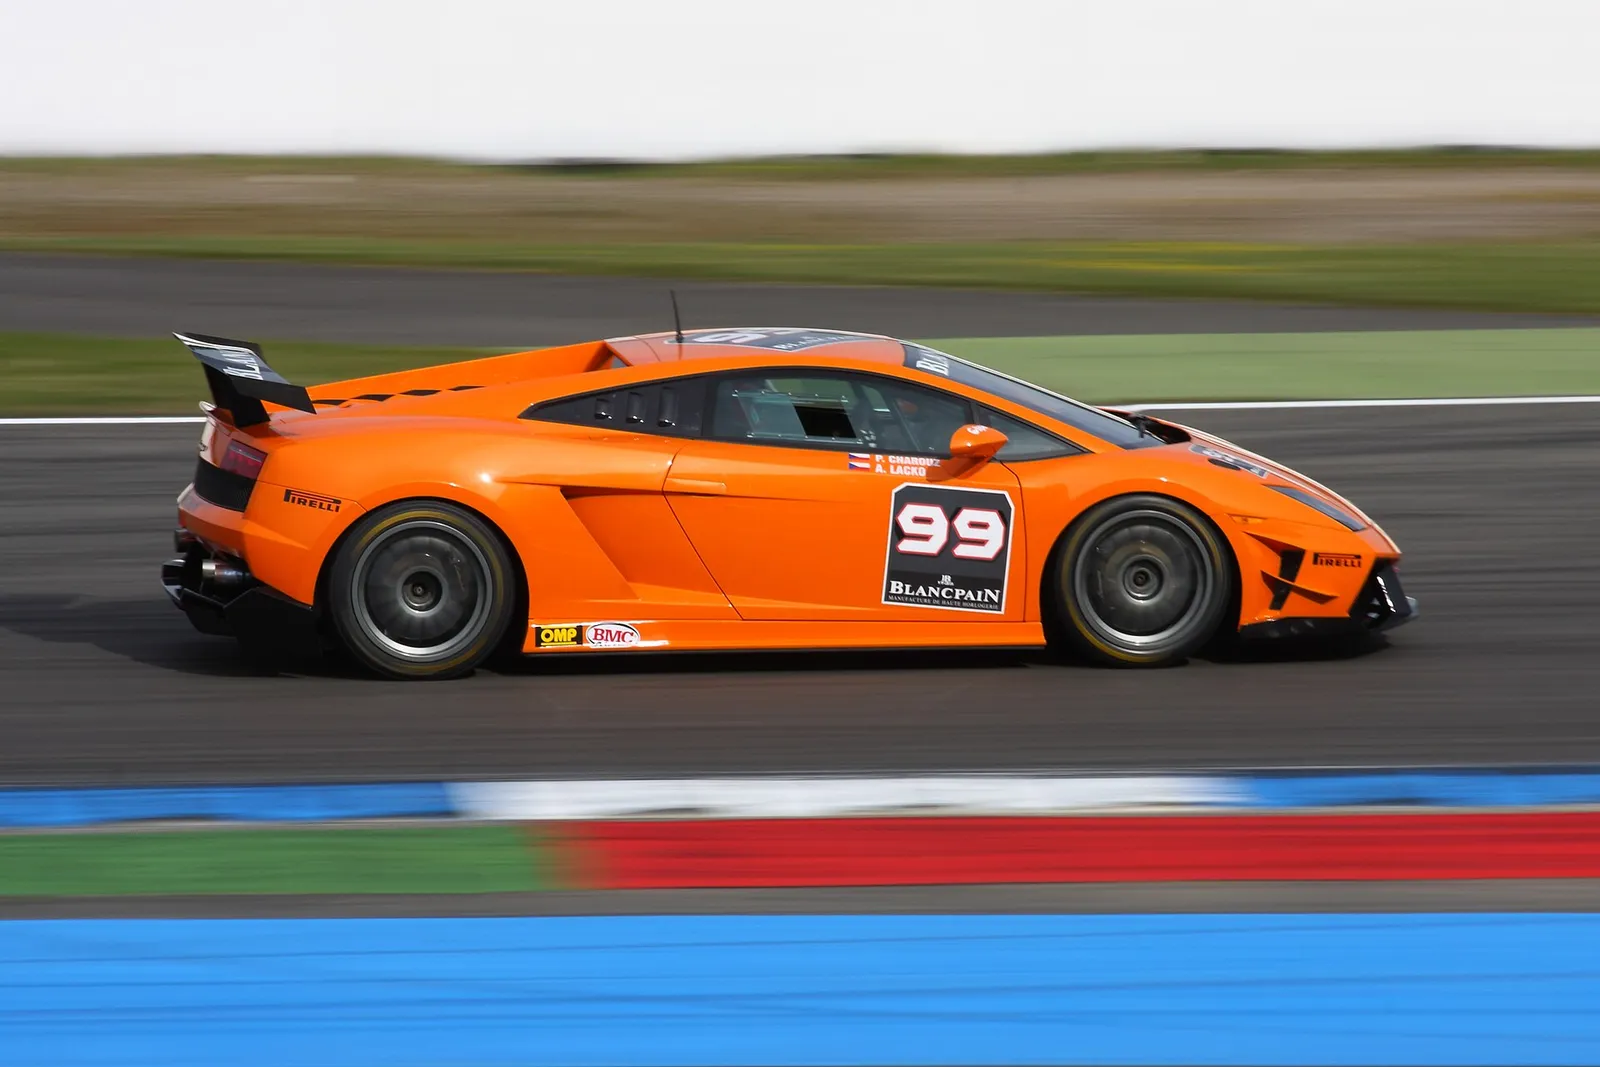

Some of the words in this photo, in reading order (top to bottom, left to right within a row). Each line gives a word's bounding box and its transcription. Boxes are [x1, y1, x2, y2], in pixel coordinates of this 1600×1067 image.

[875, 454, 885, 463] P.
[888, 455, 941, 467] CHAROUZ
[875, 465, 887, 474] A.
[890, 466, 927, 477] LACKO
[284, 489, 342, 513] PIRELLI
[896, 502, 1006, 561] 99
[1312, 552, 1362, 568] PIRELLI
[889, 580, 1001, 604] BLANCPAIN
[540, 627, 578, 643] OMP
[593, 627, 635, 643] BMC
